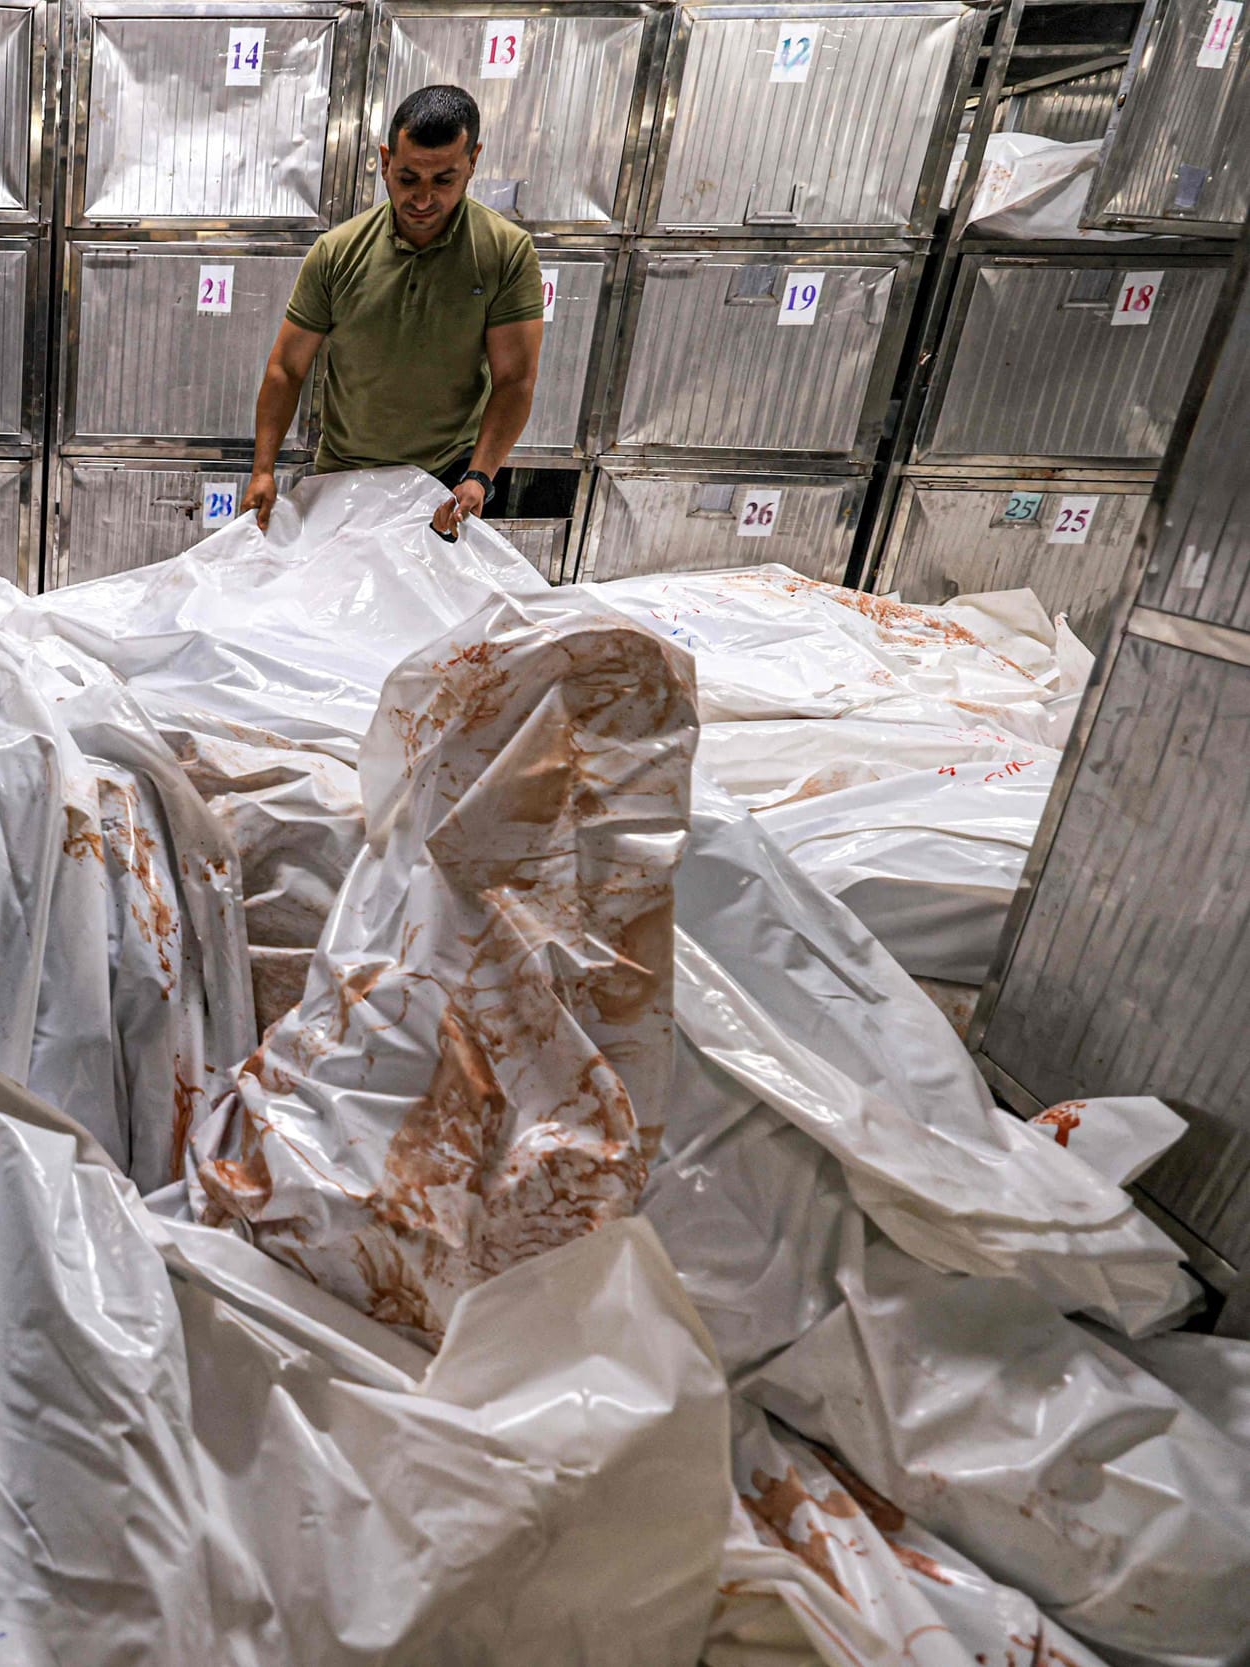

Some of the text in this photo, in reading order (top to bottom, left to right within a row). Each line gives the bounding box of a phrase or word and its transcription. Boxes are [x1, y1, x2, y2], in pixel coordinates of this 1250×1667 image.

[1207, 16, 1234, 50] 11
[232, 41, 259, 70] 14
[487, 35, 516, 64] 13
[777, 37, 811, 68] 12
[201, 278, 226, 304] 21
[542, 281, 553, 307] 0
[787, 284, 816, 310] 19
[1120, 285, 1153, 311] 18
[205, 492, 233, 518] 28
[744, 502, 773, 525] 26
[1006, 498, 1035, 519] 25
[1055, 509, 1091, 532] 25
